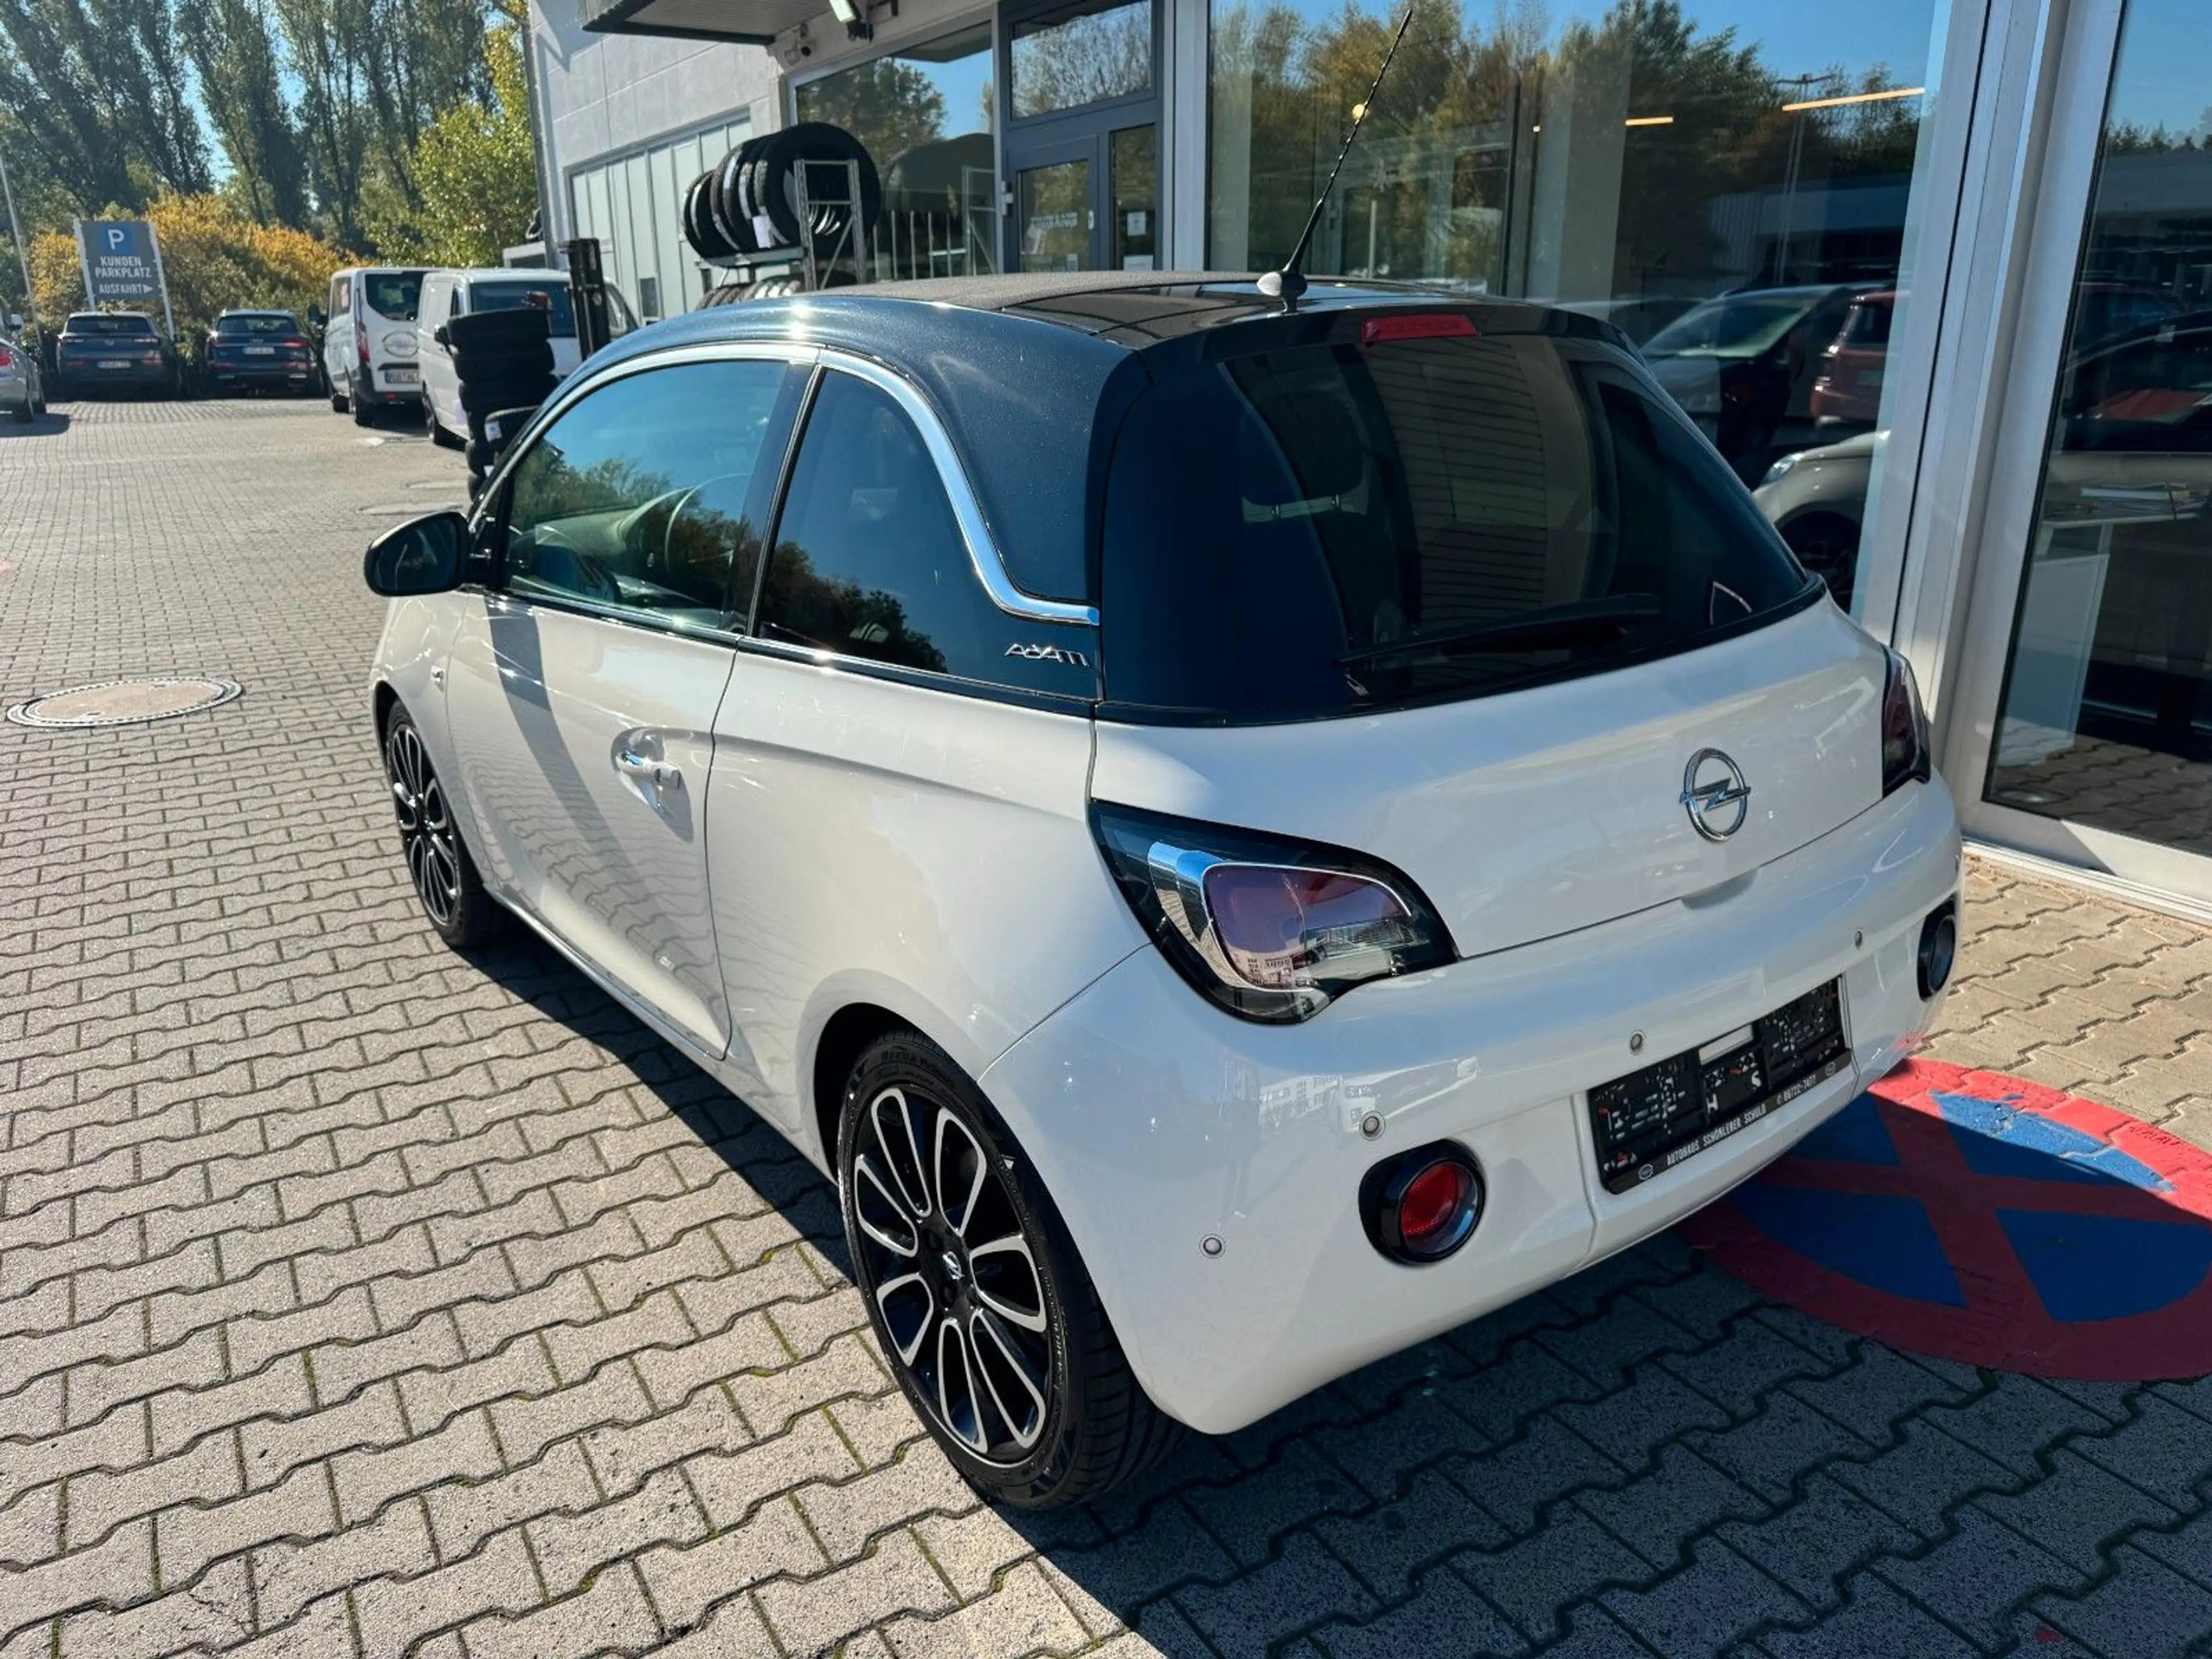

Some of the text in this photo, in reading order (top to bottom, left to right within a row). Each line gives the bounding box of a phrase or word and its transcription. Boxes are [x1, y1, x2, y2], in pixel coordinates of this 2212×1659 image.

[108, 229, 124, 250] P
[100, 256, 142, 267] KUNDEN
[94, 267, 152, 278] PARKPLATZ
[100, 283, 142, 294] AUSFAHRT
[1666, 1140, 1700, 1166] AUTOHAUS
